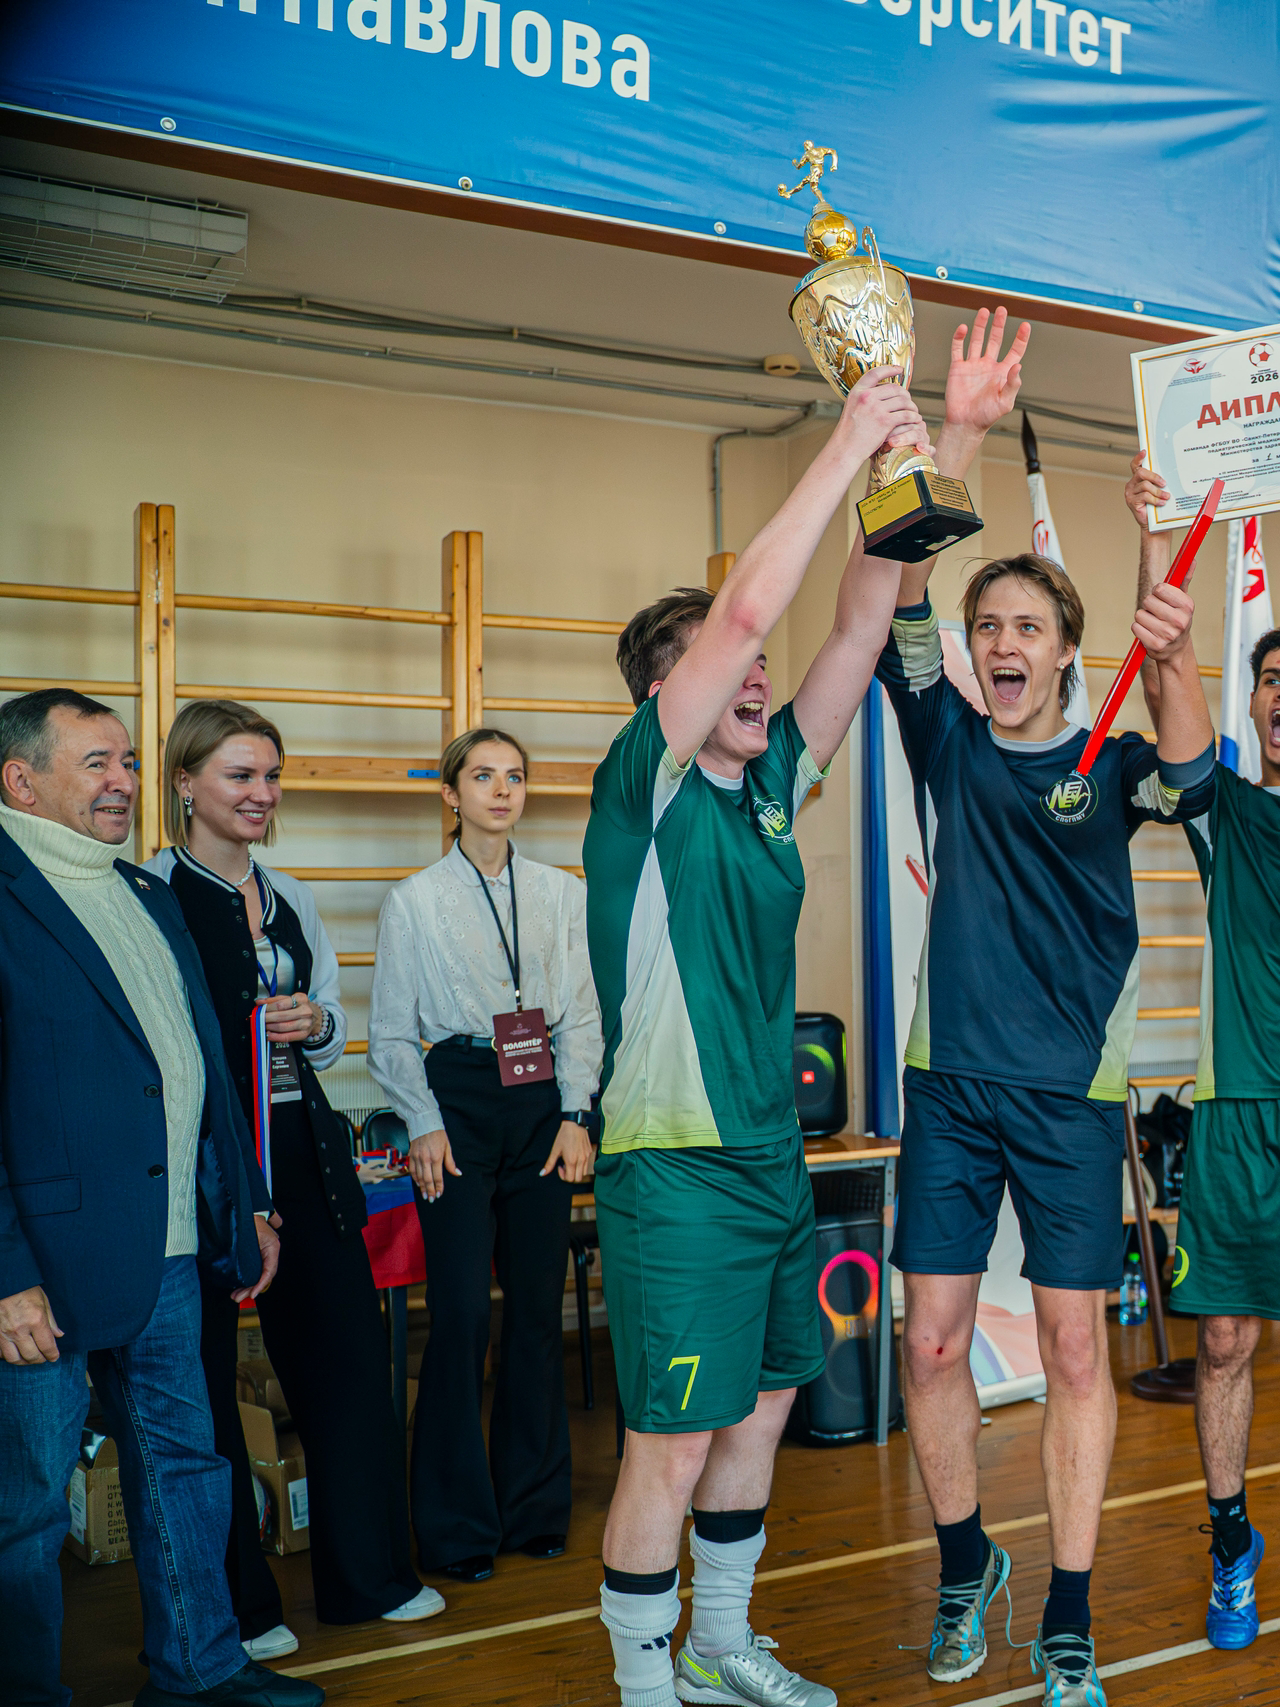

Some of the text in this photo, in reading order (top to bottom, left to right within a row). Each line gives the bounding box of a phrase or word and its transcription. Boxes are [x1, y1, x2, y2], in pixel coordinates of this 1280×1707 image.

[843, 0, 1132, 75] рситет
[1250, 372, 1279, 385] 2026
[1211, 440, 1231, 448] ФГБОУ
[667, 1355, 701, 1411] 7
